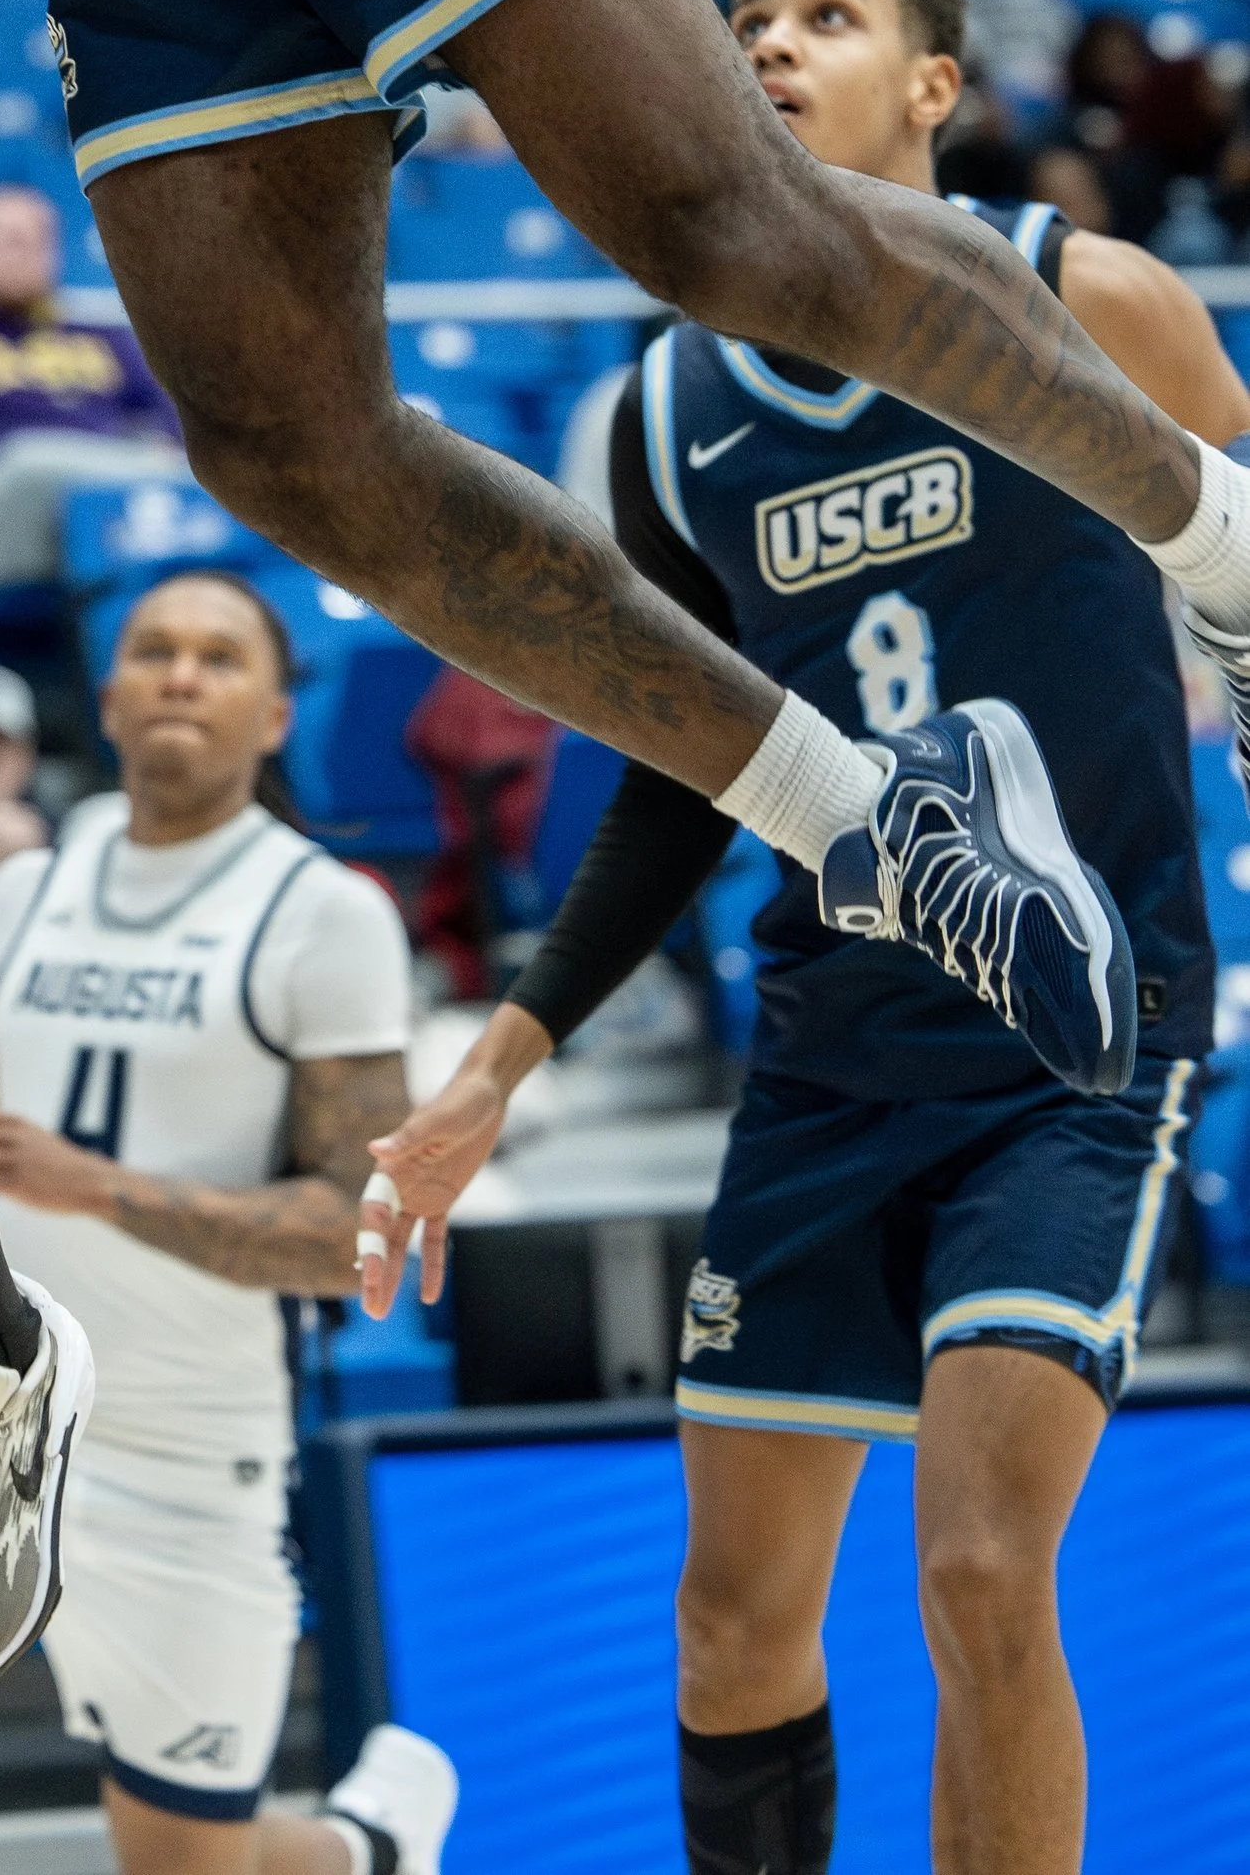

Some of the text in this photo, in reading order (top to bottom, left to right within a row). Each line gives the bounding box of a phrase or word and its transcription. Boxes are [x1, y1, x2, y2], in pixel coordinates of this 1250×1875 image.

[765, 459, 960, 582] USCB
[846, 589, 940, 736] 8
[17, 961, 204, 1029] AUGUSTA
